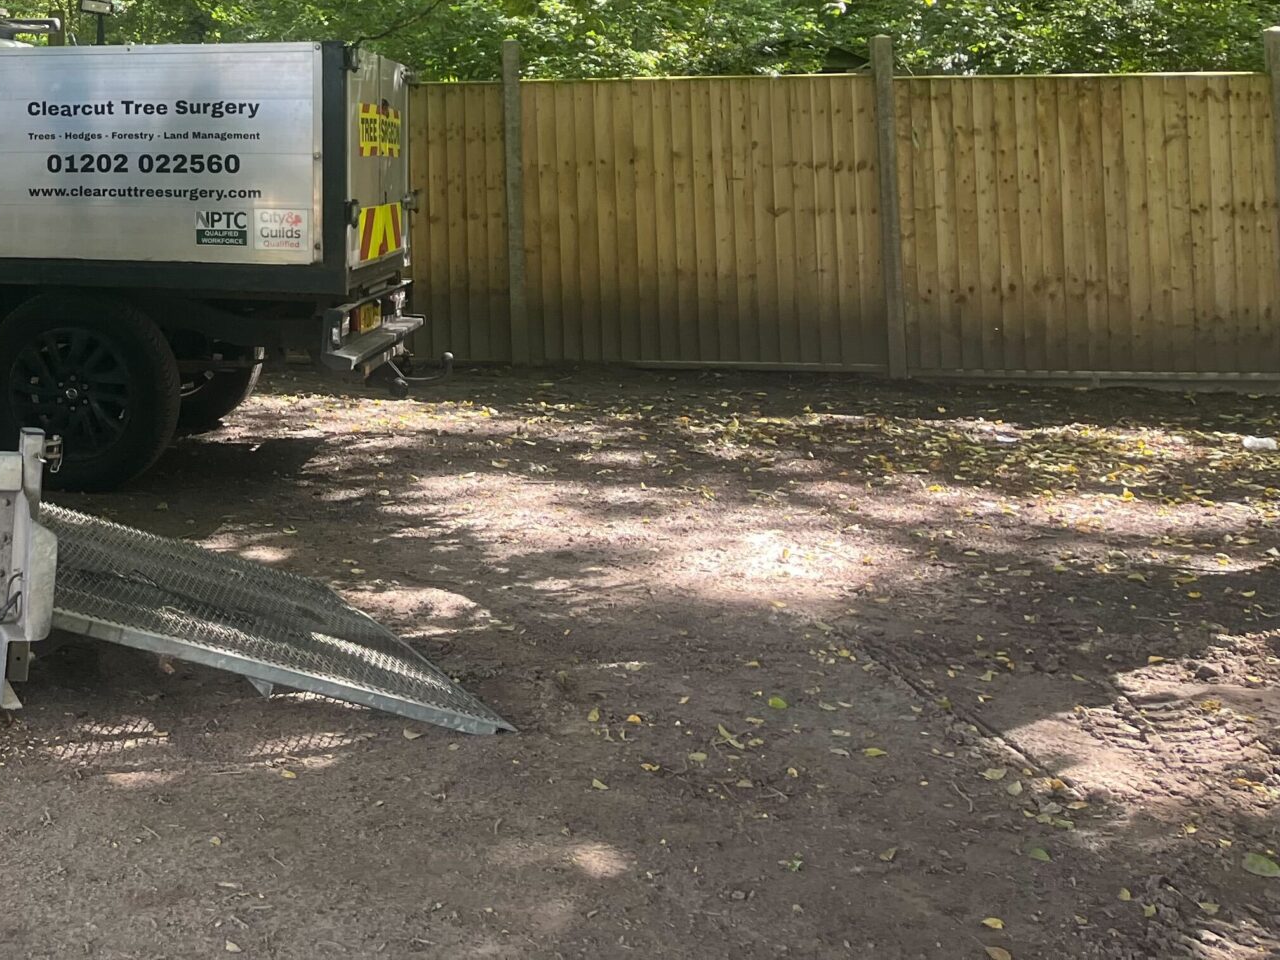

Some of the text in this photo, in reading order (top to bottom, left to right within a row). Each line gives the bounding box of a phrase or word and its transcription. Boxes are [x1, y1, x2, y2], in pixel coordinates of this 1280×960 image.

[27, 99, 261, 119] Clearcut Tree Surgery
[28, 132, 56, 141] Trees
[64, 132, 103, 142] Hedges
[111, 131, 155, 142] Forestry
[163, 131, 190, 140] Land
[192, 131, 261, 141] Management
[361, 117, 378, 143] TREE
[46, 153, 241, 174] 01202 022560
[28, 186, 263, 202] www.clearcuttreesurgery.com
[196, 211, 247, 230] NPTC
[204, 230, 239, 238] QUALIFIED
[260, 226, 301, 239] Guilds
[263, 240, 300, 249] Qualified
